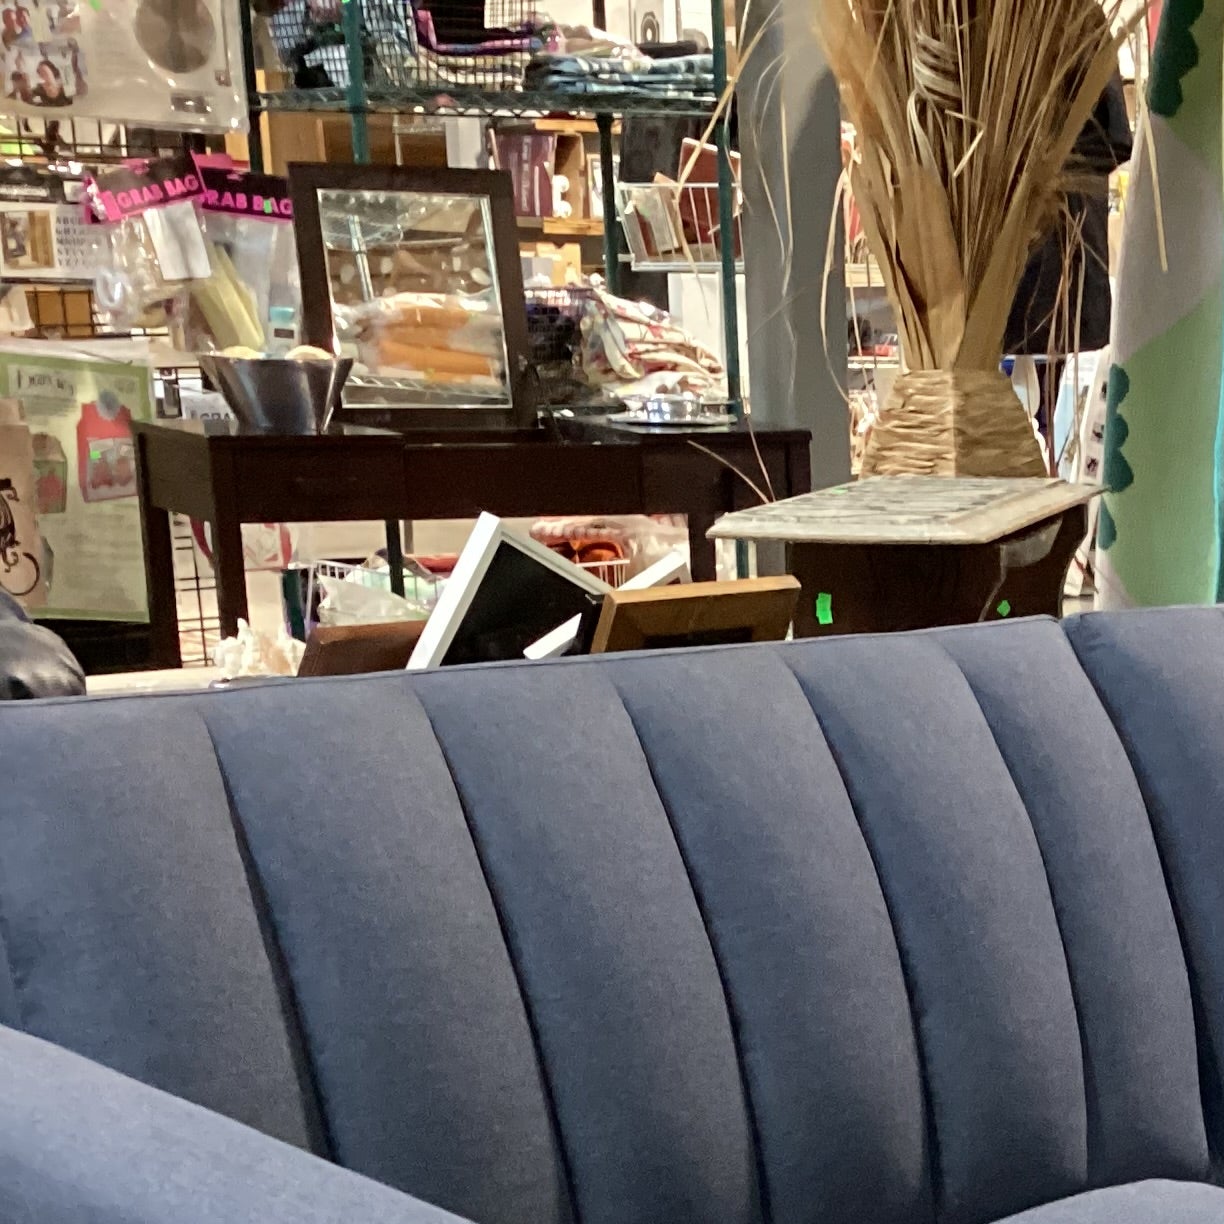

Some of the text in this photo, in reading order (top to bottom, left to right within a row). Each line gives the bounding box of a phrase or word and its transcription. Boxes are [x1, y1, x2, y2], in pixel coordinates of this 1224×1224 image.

[116, 174, 199, 209] GRAB BAG
[203, 190, 248, 210] RAB
